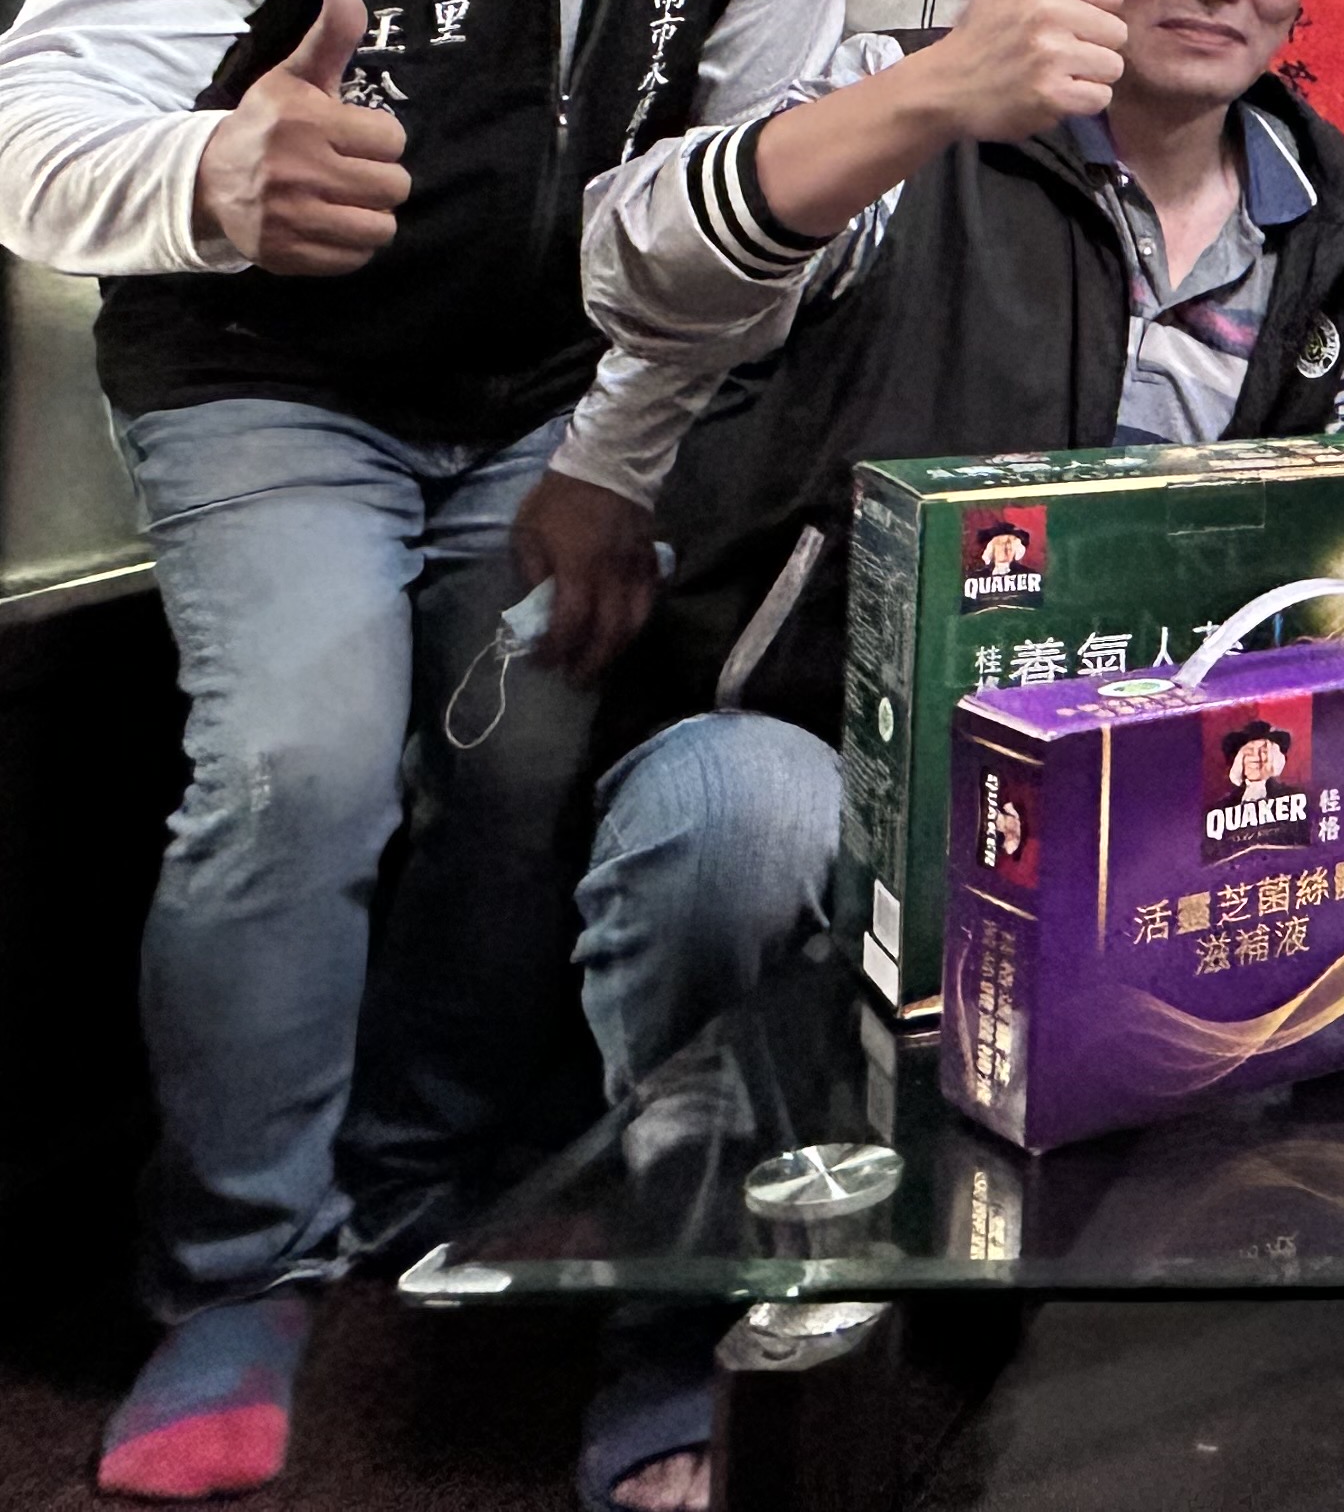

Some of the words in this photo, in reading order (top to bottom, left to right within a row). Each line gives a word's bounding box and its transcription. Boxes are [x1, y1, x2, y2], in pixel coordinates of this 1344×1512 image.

[964, 573, 1042, 600] QUAKER
[1206, 793, 1307, 840] QUAKER
[1318, 788, 1341, 842] 桂格
